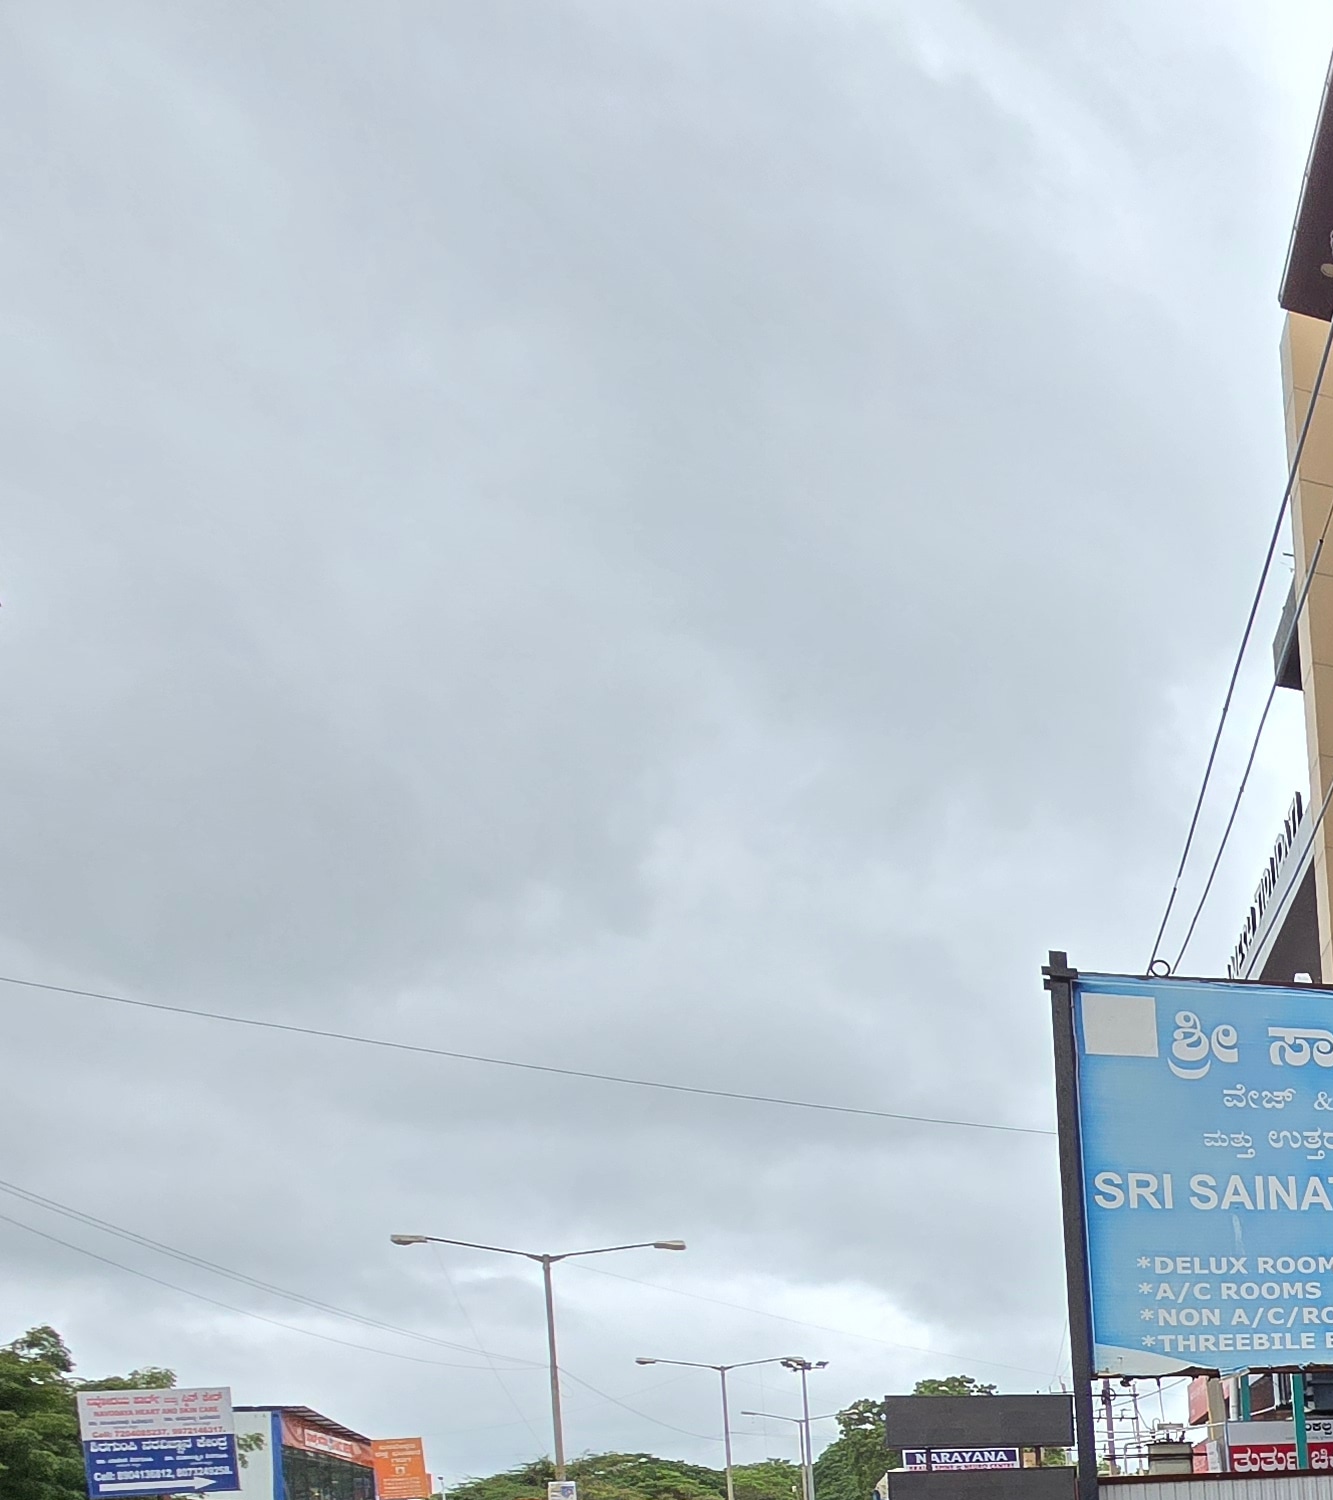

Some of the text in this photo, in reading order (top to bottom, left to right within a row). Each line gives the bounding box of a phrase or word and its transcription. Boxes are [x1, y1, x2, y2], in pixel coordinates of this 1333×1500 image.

[1167, 1010, 1239, 1080] ಶ್ರೀ
[1223, 1083, 1297, 1109] ವೇಜ್
[1203, 1129, 1256, 1159] ಮತ್ತು
[1093, 1171, 1174, 1210] SRI
[1221, 1281, 1322, 1300] ROOMS
[915, 1451, 1008, 1464] NARAYANA
